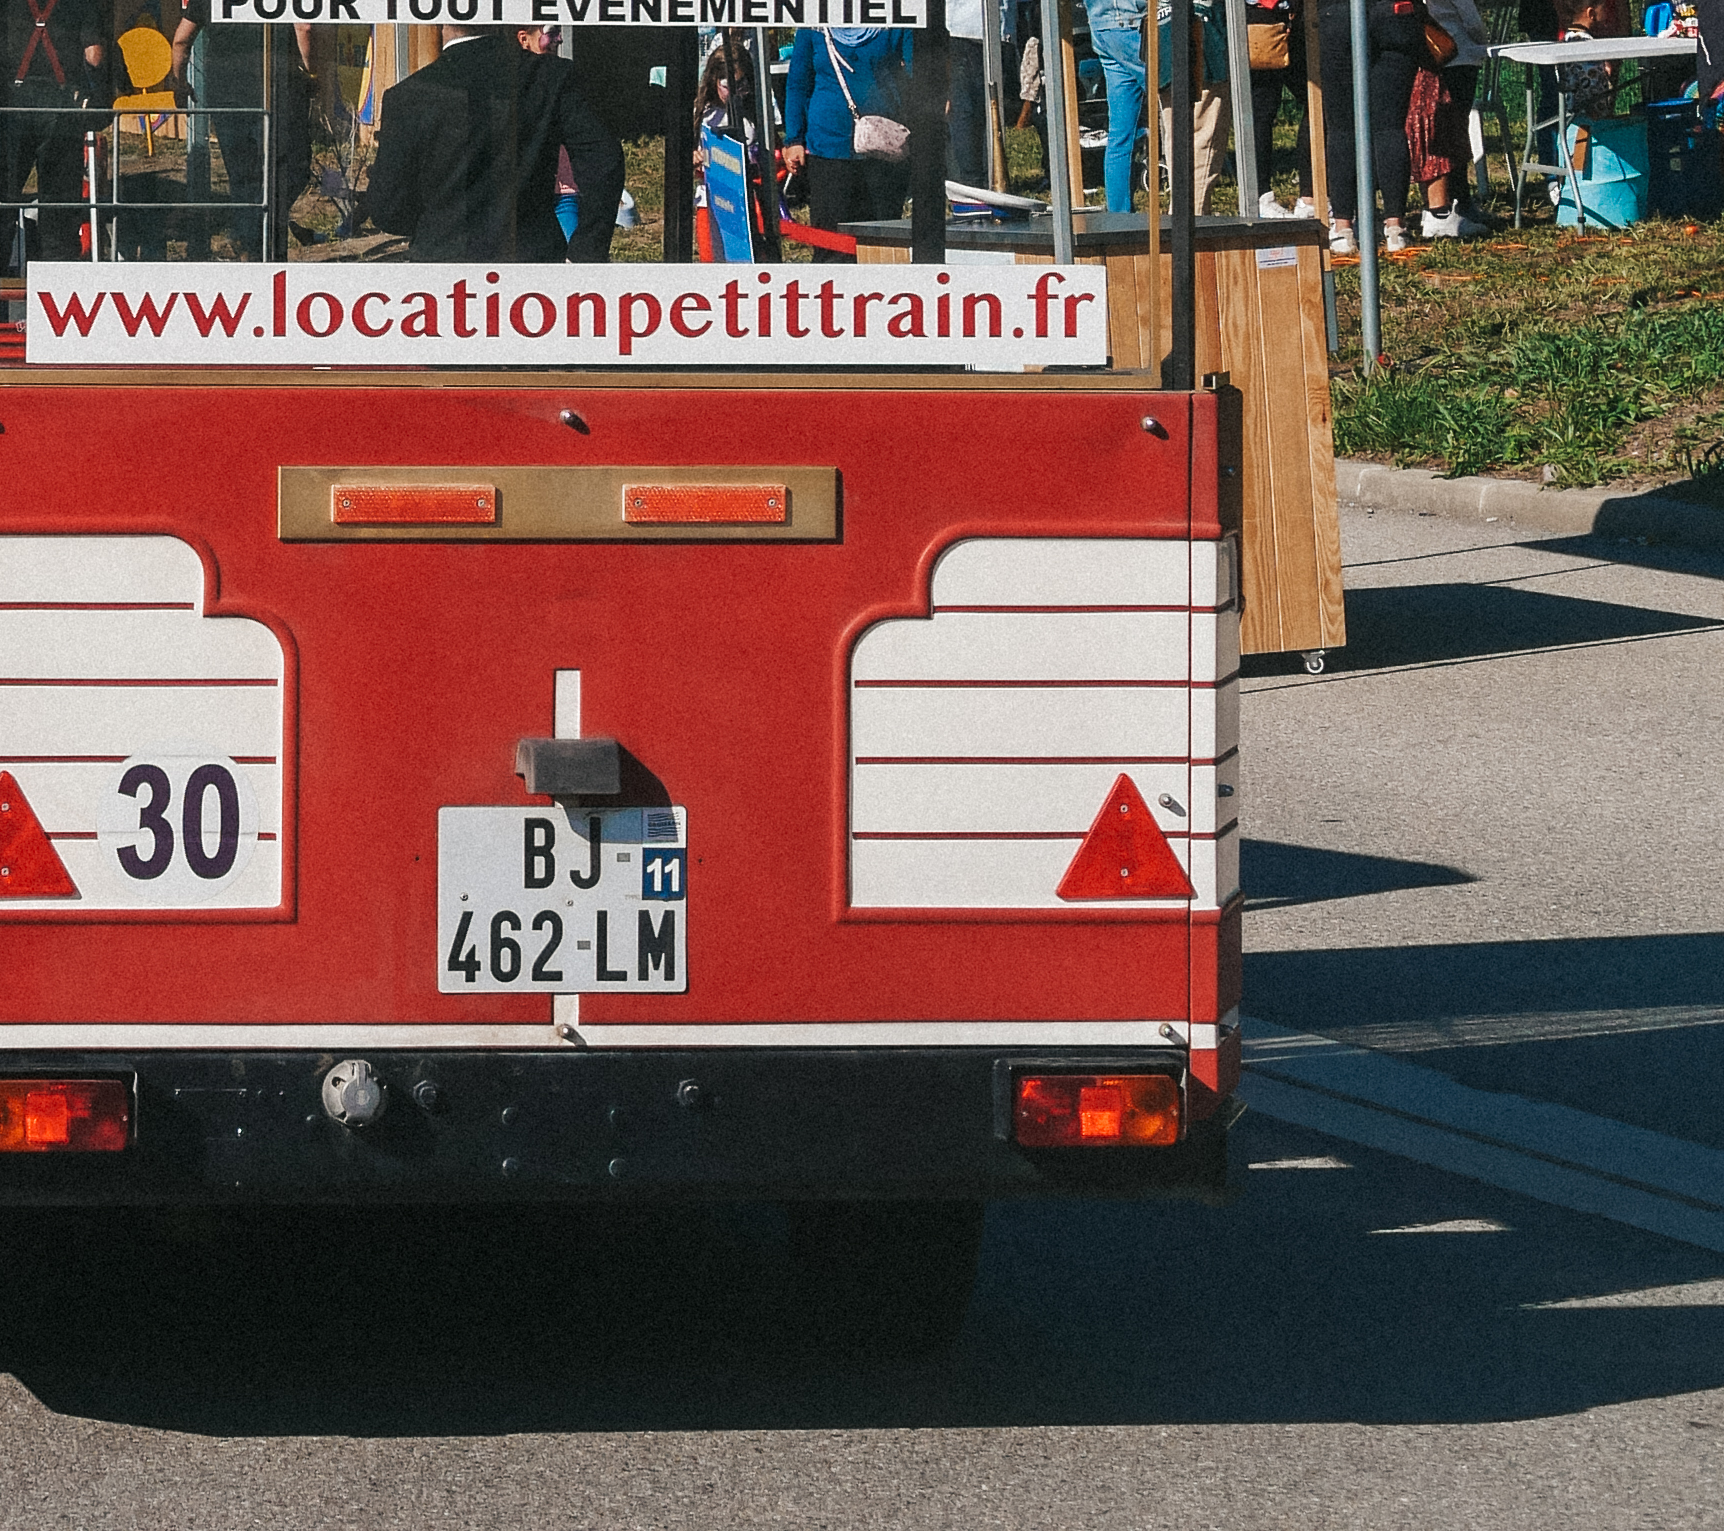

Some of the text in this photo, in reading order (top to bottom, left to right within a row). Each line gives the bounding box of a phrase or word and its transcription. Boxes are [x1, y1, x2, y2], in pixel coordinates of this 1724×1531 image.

[38, 271, 1094, 355] www.locationpetittrain.fr
[116, 763, 240, 880] 30
[646, 857, 680, 892] 11
